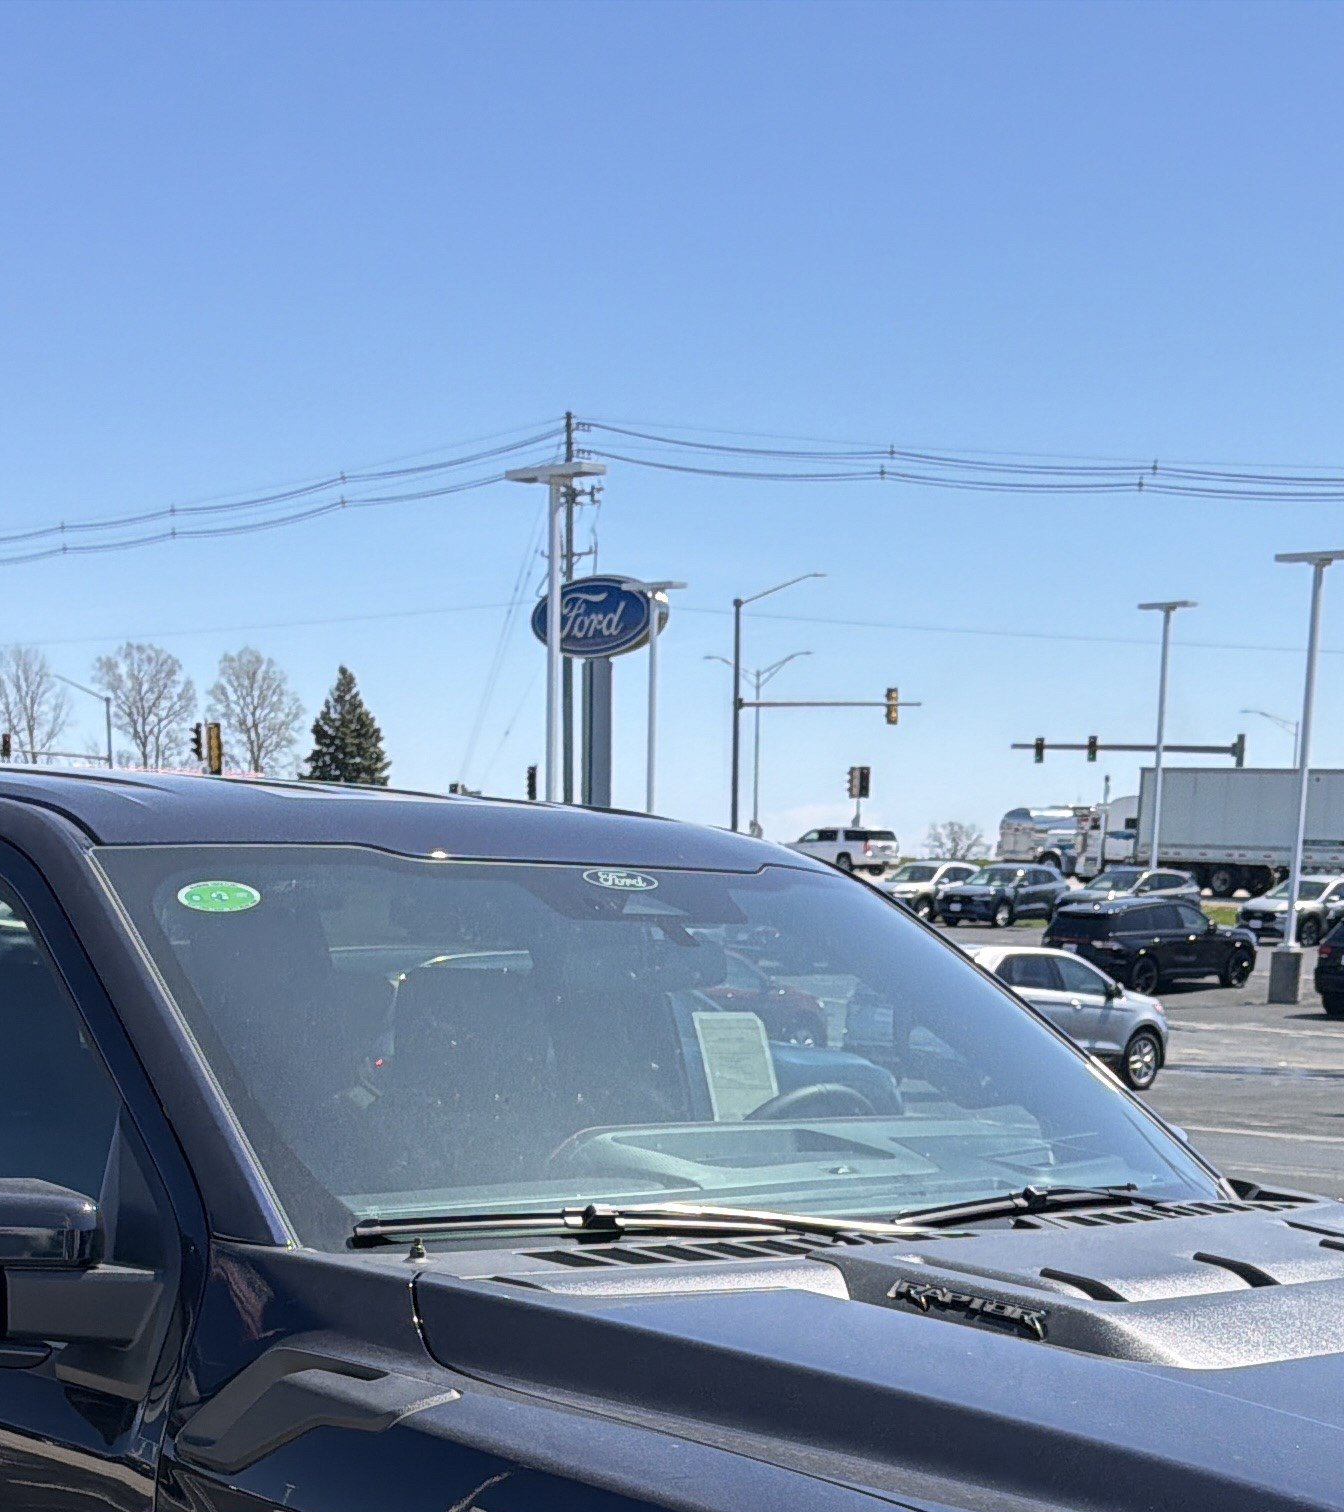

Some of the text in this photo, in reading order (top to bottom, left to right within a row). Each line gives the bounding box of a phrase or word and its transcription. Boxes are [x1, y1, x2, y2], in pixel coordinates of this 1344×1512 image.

[560, 592, 626, 639] Ford
[597, 871, 647, 888] Ford
[886, 1278, 1049, 1342] RAPTOR
